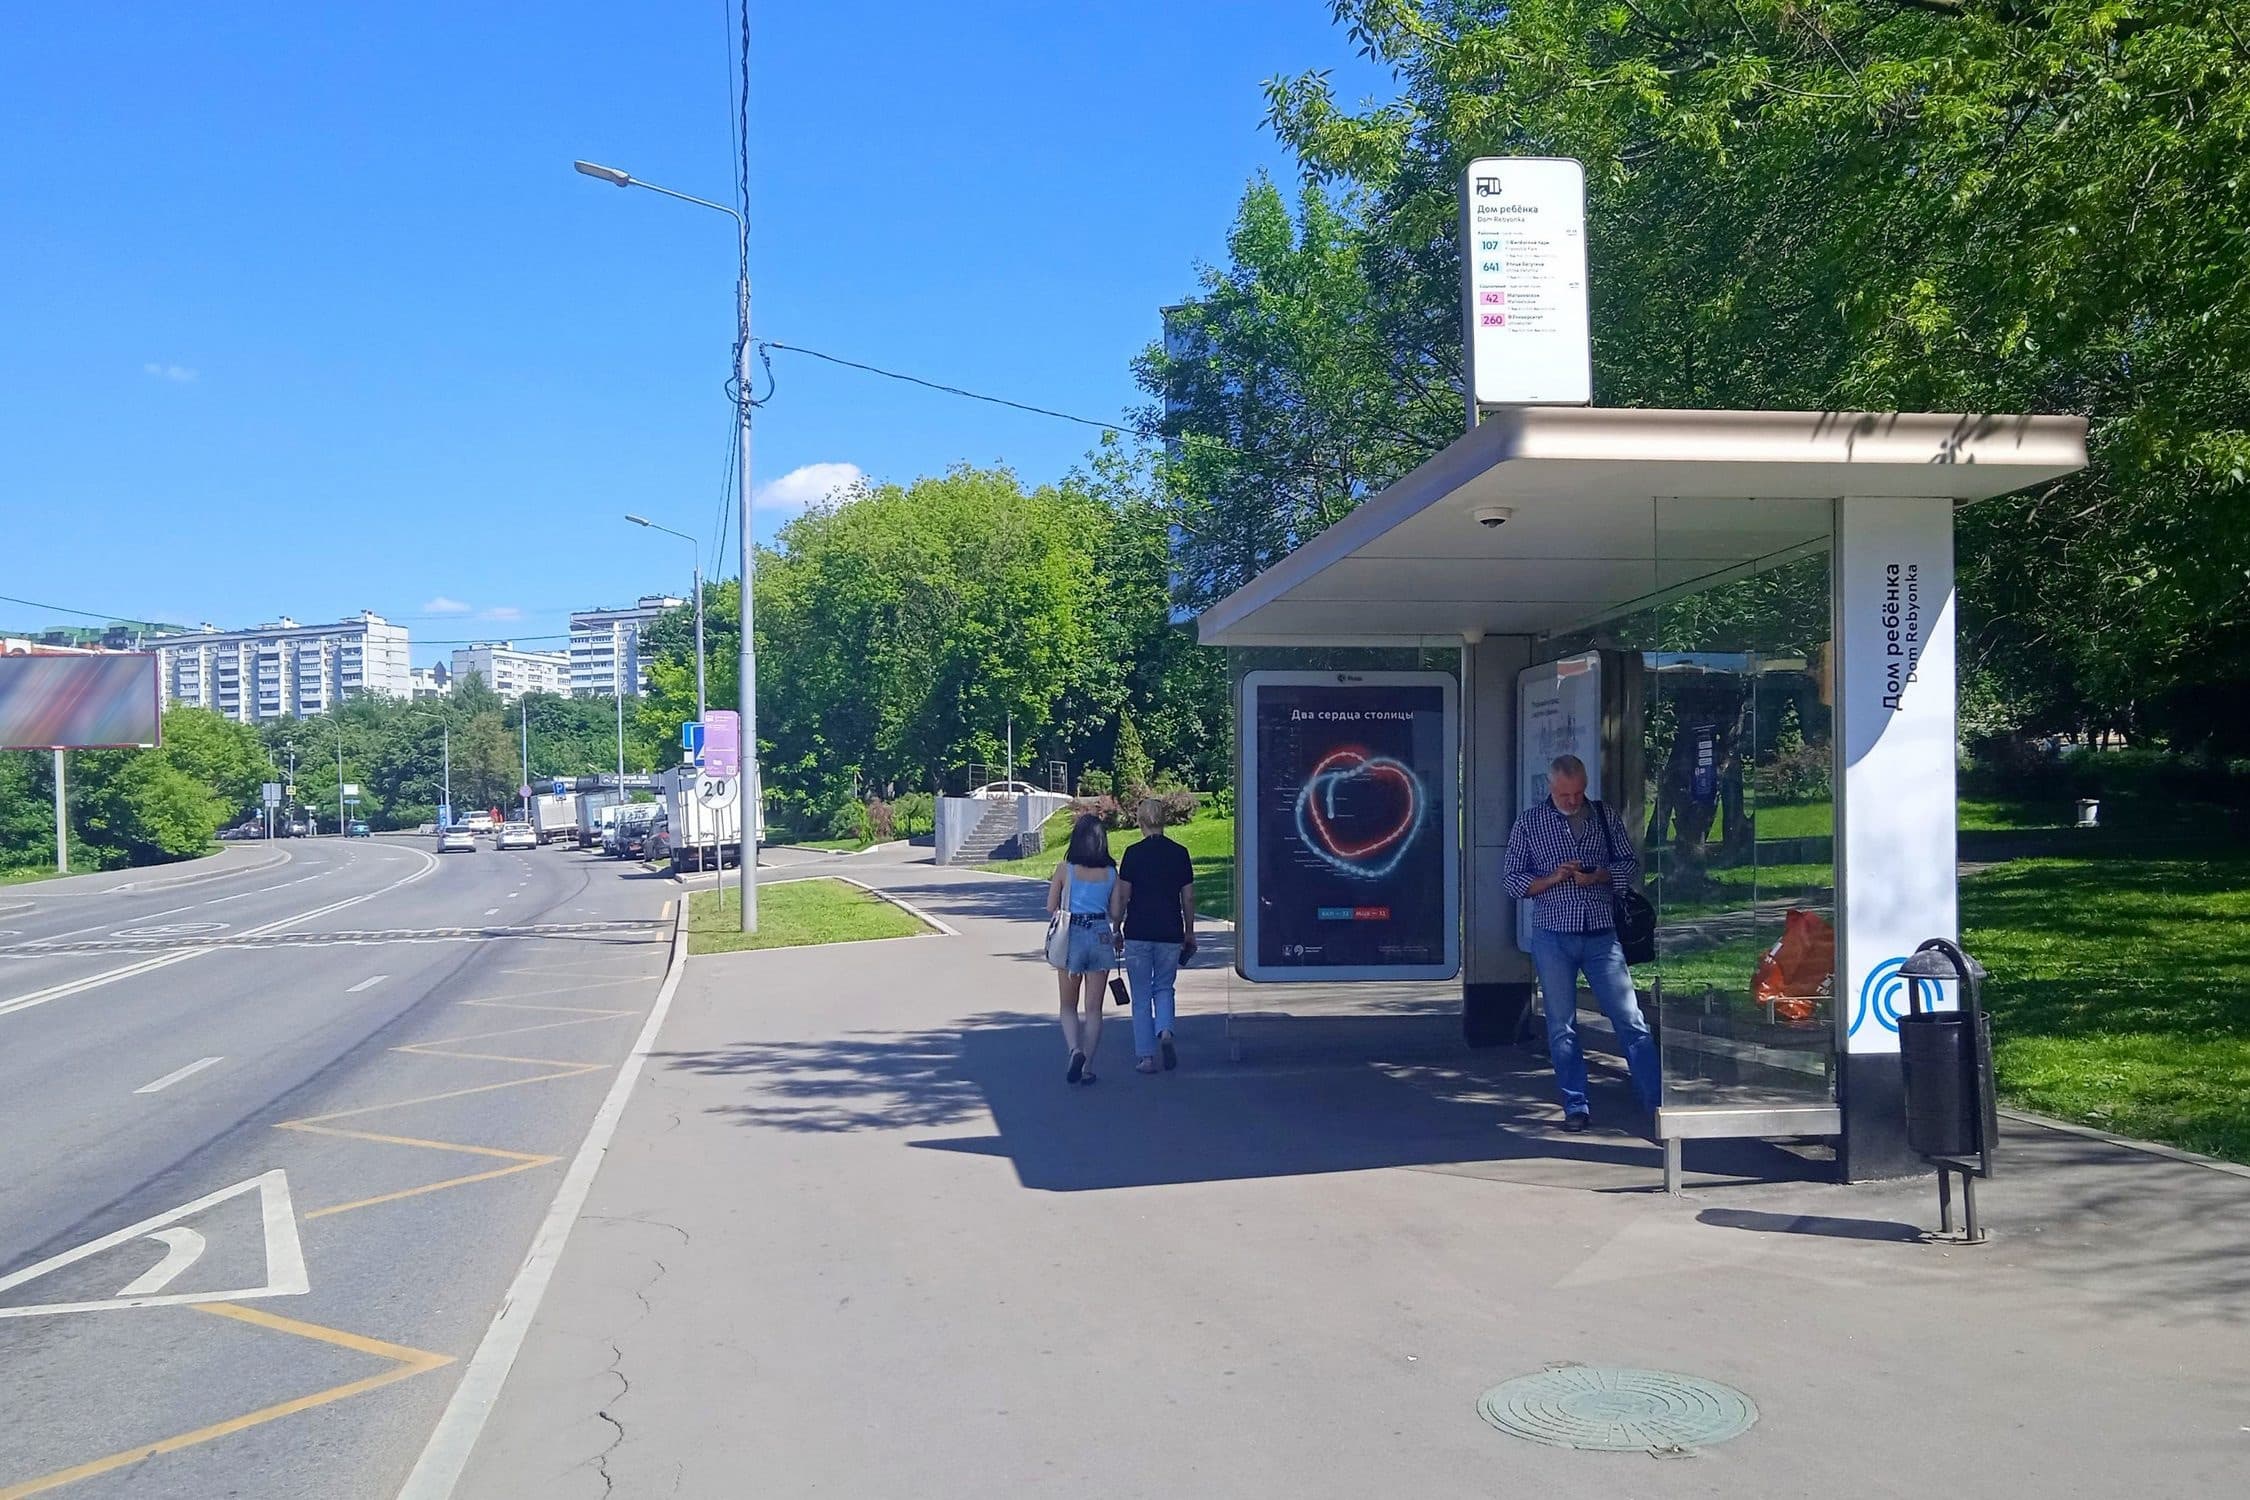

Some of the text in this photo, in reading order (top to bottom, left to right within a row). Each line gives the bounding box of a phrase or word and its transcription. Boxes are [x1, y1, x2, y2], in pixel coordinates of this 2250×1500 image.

[1477, 204, 1539, 215] Дом ребёнка
[1482, 241, 1499, 250] 107
[1483, 262, 1500, 272] 641
[1486, 294, 1499, 303] 42
[1483, 315, 1503, 325] 260
[1905, 564, 1920, 683] Dom Rebyonka
[1882, 564, 1904, 711] Дом ребёнка
[1291, 709, 1414, 722] Два сердца столицы
[704, 780, 726, 797] 20
